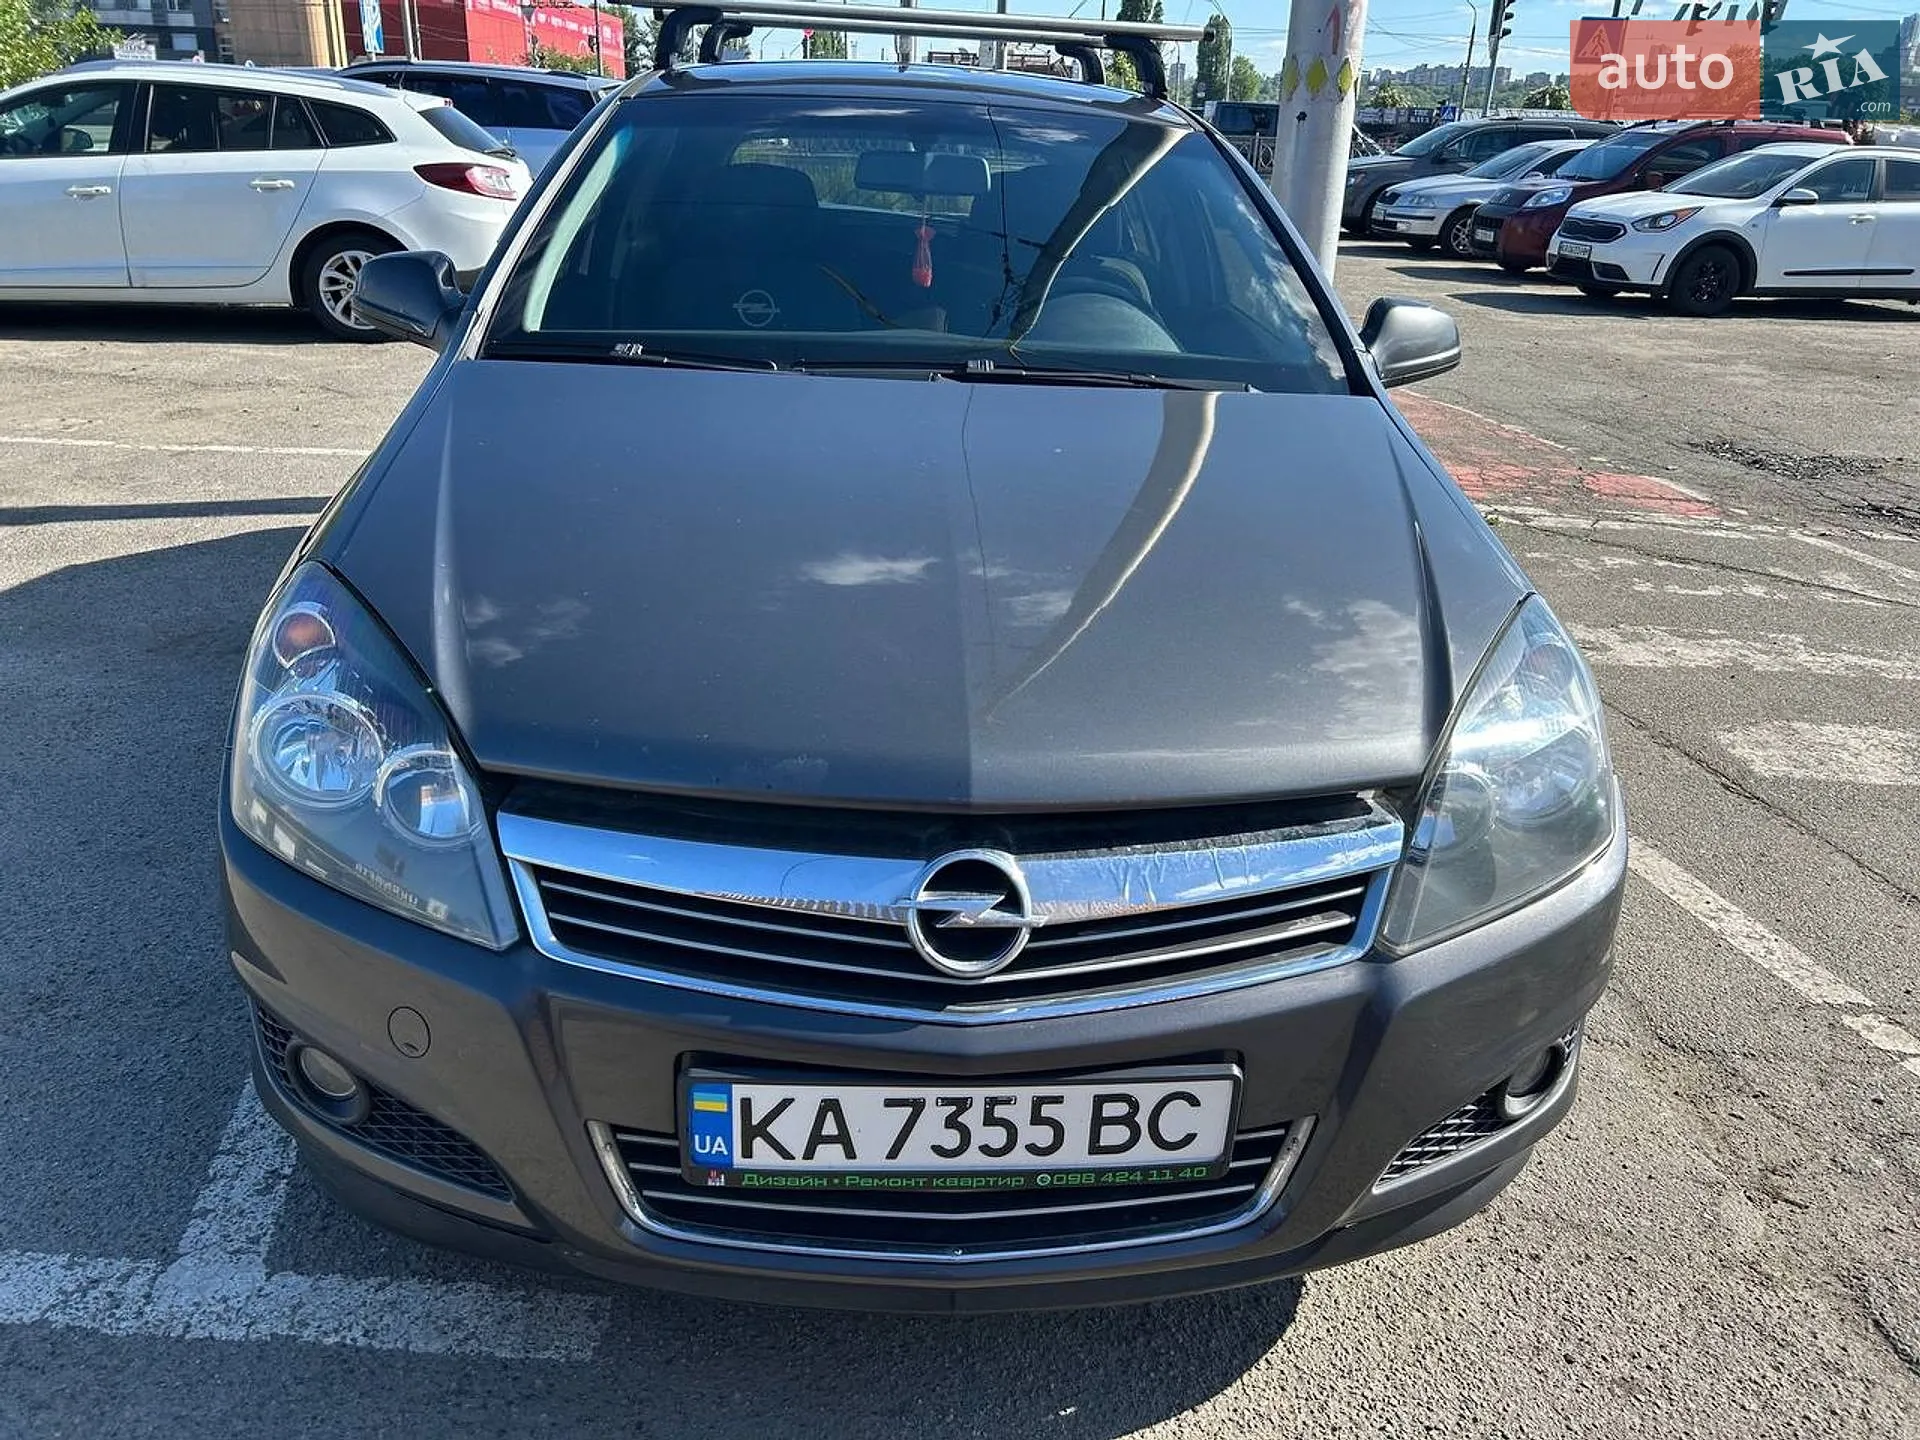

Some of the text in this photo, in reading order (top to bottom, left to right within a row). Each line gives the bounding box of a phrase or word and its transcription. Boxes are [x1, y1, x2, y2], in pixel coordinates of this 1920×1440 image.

[740, 1091, 1202, 1160] KA 7355 BC
[694, 1134, 728, 1155] UA
[742, 1167, 1208, 1188] Дизайн Ремонт квартир 098 424 11 40
